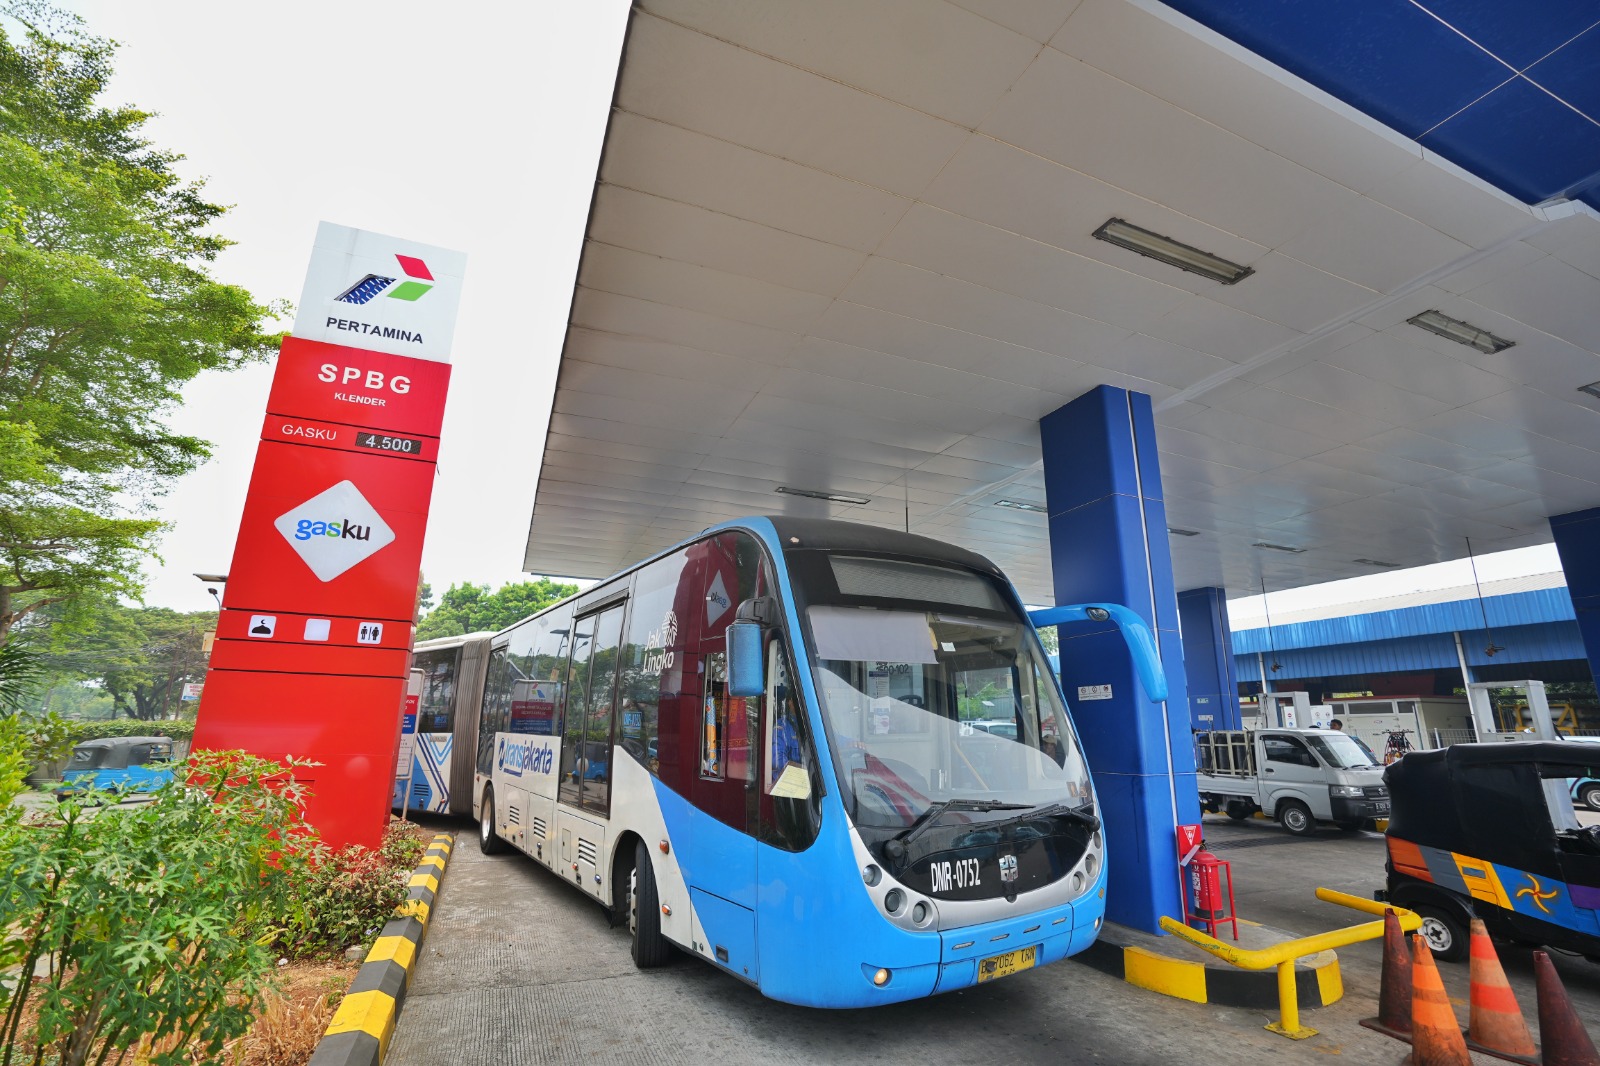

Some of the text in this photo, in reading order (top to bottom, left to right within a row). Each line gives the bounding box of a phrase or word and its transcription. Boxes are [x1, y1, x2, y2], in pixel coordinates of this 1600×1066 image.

[326, 316, 423, 344] PERTAMINA
[318, 363, 412, 395] SPBG
[334, 392, 386, 407] KLENDER
[281, 424, 412, 452] GASKU 4.500
[294, 518, 371, 541] gasku
[644, 628, 662, 651] Jak
[642, 648, 675, 676] Lingko
[504, 738, 553, 778] transjakarta
[930, 858, 981, 893] DMR-0752
[994, 952, 1015, 970] 7062
